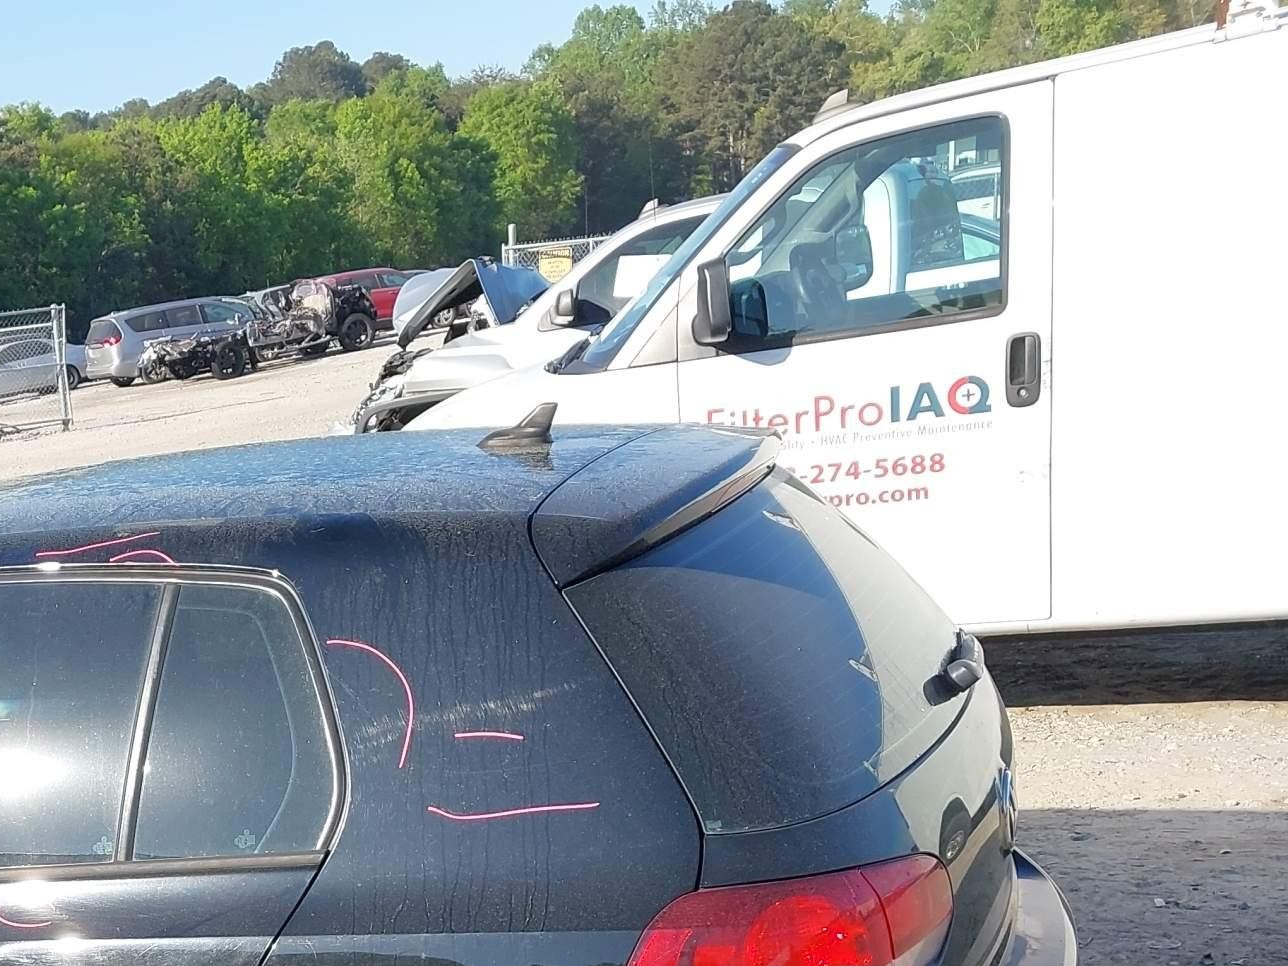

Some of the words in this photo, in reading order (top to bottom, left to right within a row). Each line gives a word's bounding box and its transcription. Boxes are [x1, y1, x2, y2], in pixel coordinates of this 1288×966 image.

[821, 433, 847, 446] HVAC
[853, 430, 912, 442] Preventive
[916, 420, 993, 436] Maintenance
